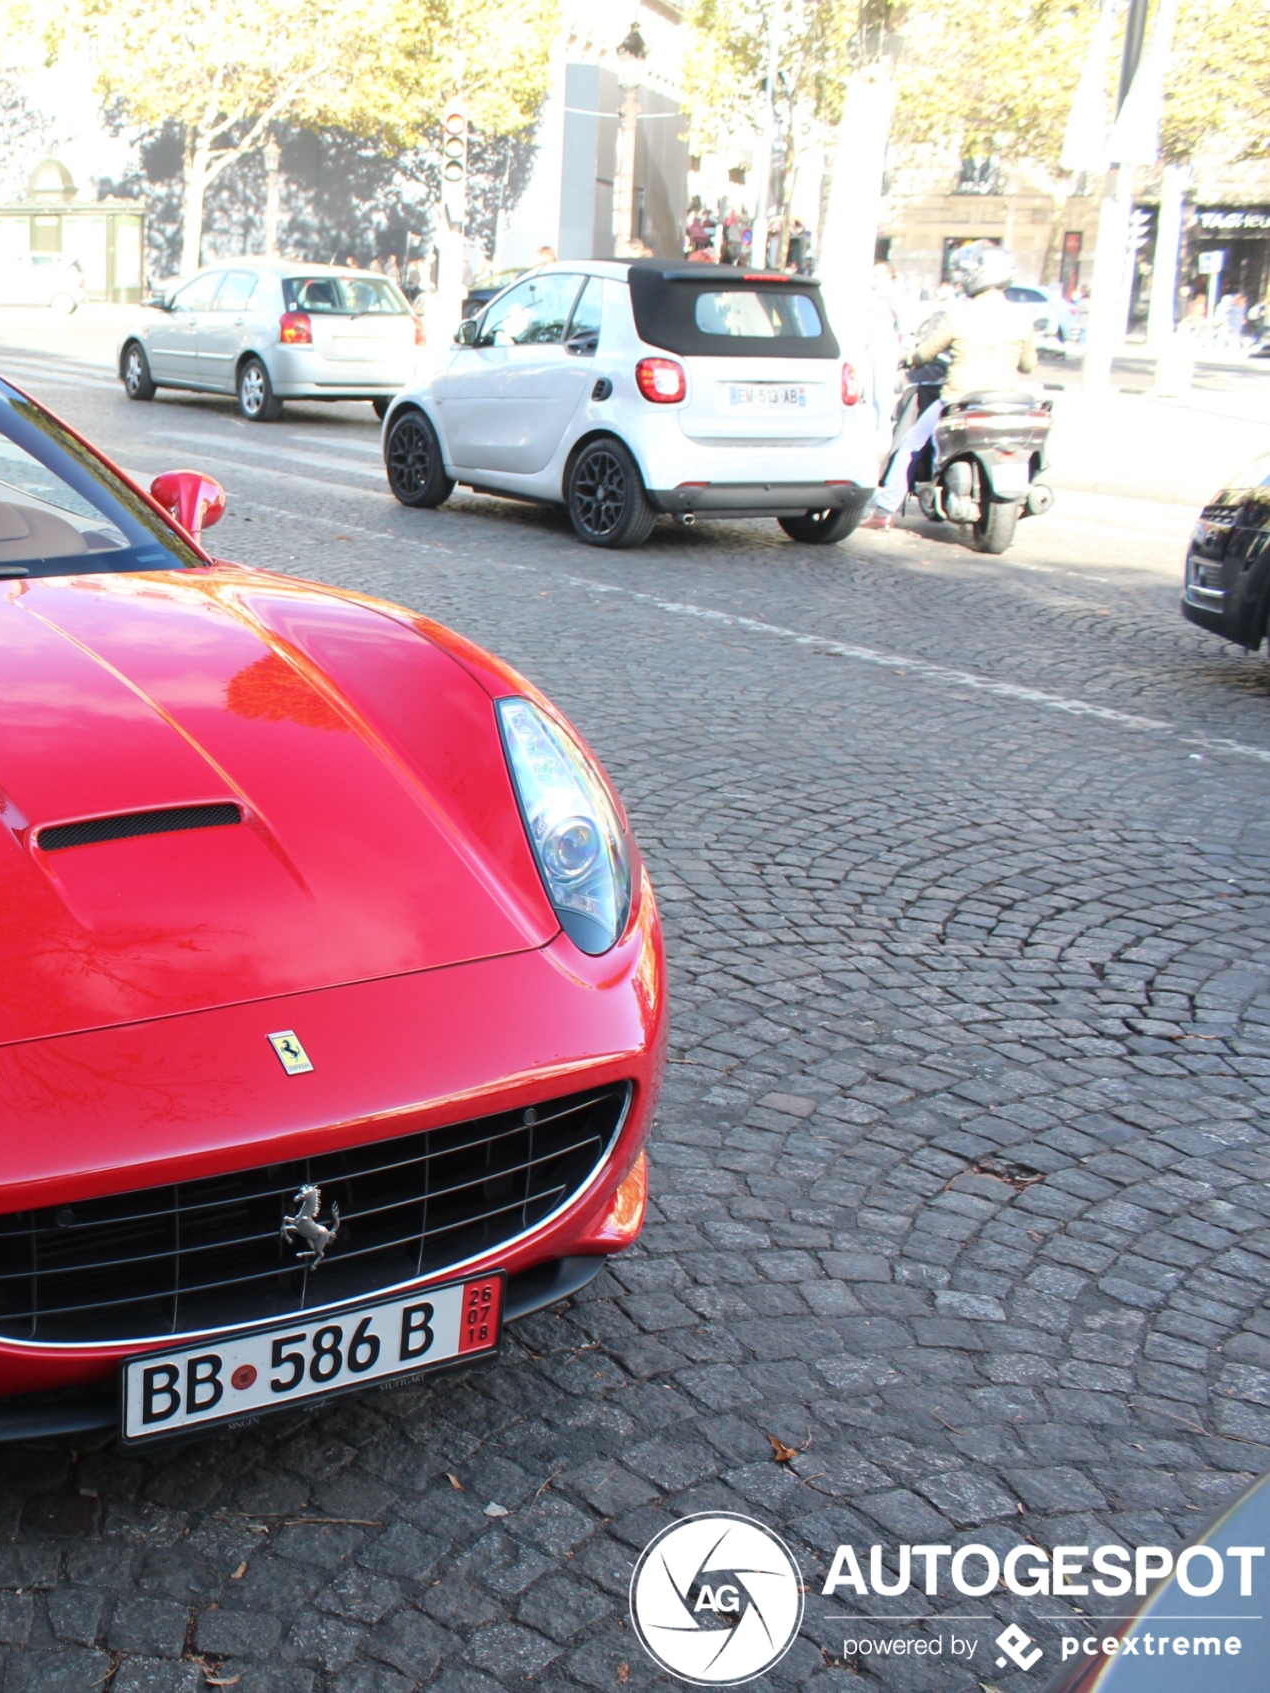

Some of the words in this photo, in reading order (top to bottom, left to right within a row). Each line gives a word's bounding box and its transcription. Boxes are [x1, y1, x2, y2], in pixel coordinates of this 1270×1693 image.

[468, 1285, 493, 1306] 26
[466, 1304, 491, 1325] 07
[467, 1325, 489, 1344] 18
[142, 1353, 224, 1425] BB
[270, 1315, 381, 1393] 586
[398, 1301, 435, 1362] B
[379, 1373, 426, 1392] STUTTGART
[227, 1417, 261, 1431] SINGEN
